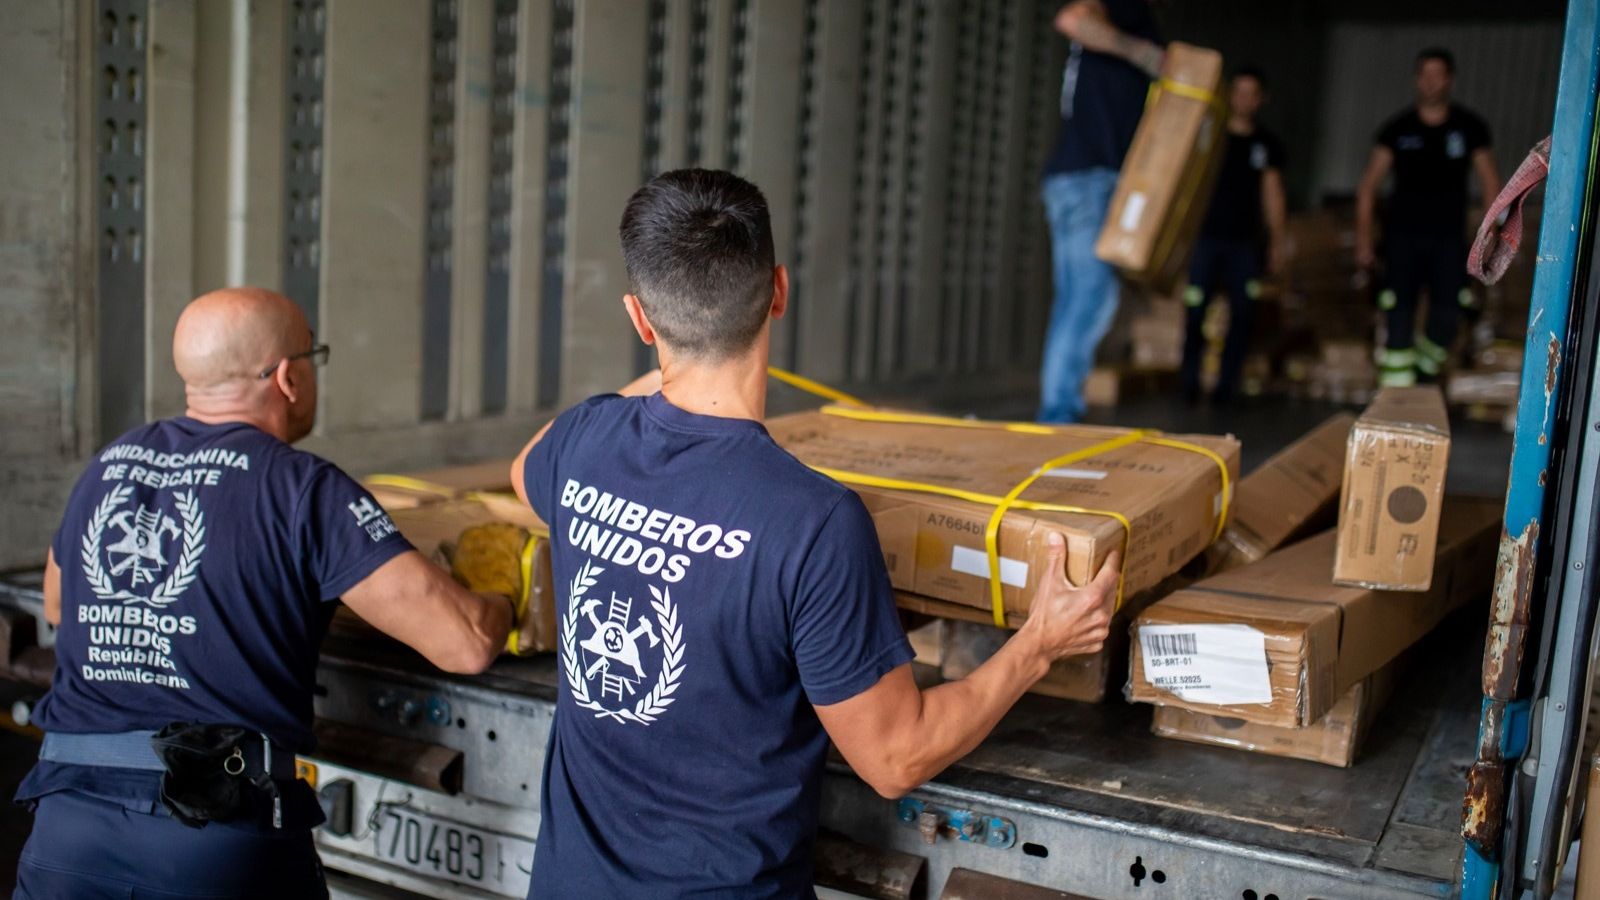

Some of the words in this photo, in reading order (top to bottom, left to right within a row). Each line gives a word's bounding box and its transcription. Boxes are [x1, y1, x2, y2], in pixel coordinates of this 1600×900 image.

[101, 464, 129, 481] DE
[560, 478, 752, 559] BOMBEROS
[568, 516, 691, 583] UNIDOS
[89, 626, 172, 656] UNIDOS
[82, 665, 191, 690] Dominicana
[387, 811, 484, 881] 70483
